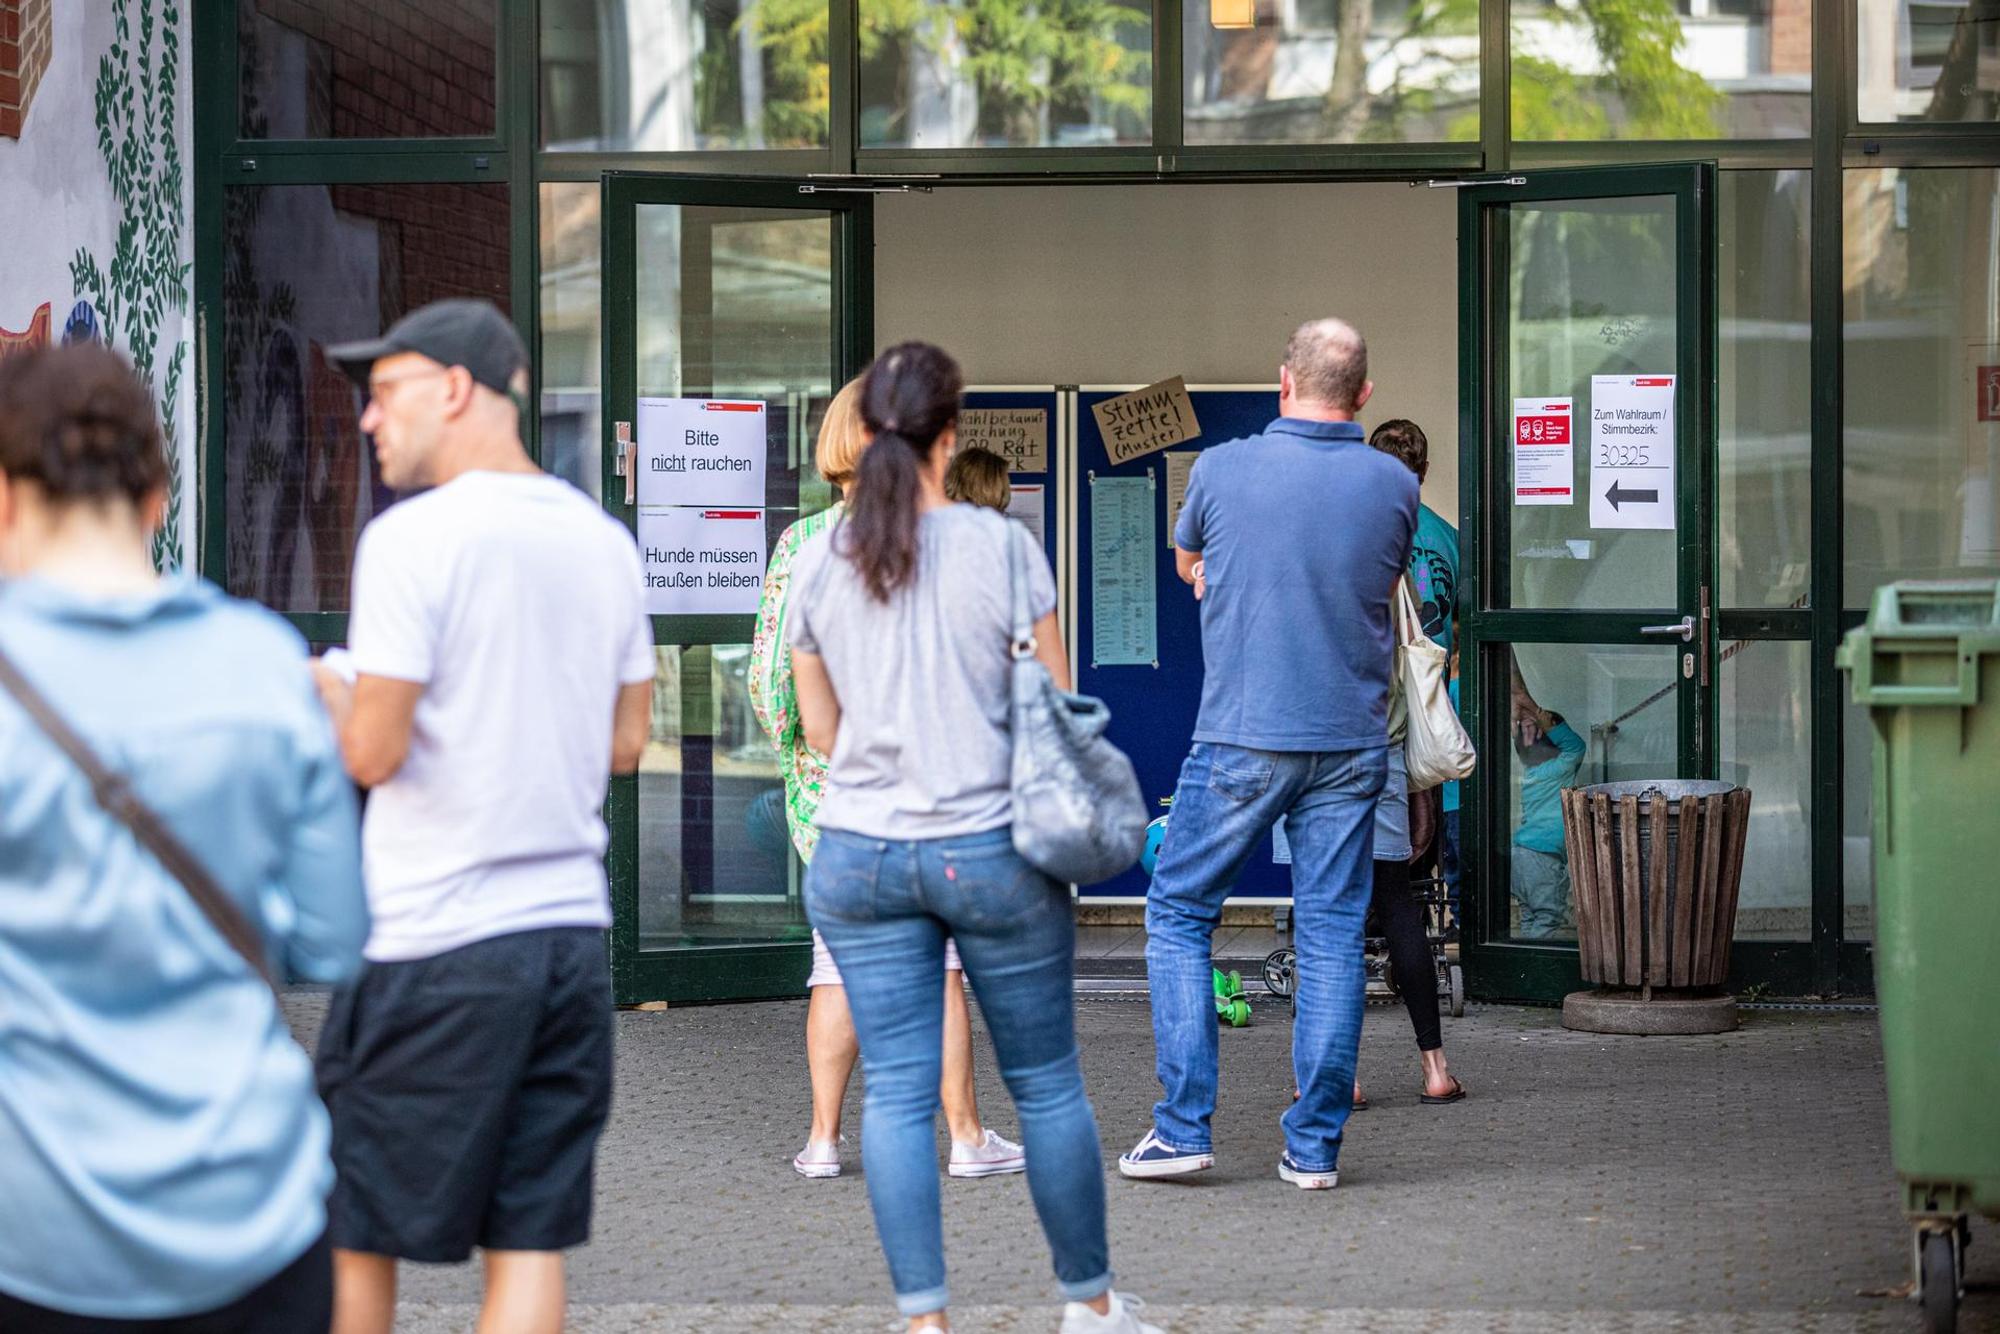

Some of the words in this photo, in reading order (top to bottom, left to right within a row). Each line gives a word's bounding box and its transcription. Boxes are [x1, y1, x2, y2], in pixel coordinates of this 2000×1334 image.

[1102, 391, 1181, 426] Stimm-
[1594, 409, 1614, 420] Zum
[1616, 409, 1661, 420] Wahlraum
[1602, 423, 1658, 435] Stimmbezirk:
[685, 429, 719, 446] Bitte
[1115, 423, 1185, 460] (Muster)
[1003, 440, 1038, 456] Rat
[1601, 444, 1649, 466] 30325
[651, 454, 686, 471] nicht
[691, 455, 752, 471] rauchen
[646, 547, 695, 563] Hunde
[699, 547, 758, 563] müssen
[708, 572, 760, 588] bleiben
